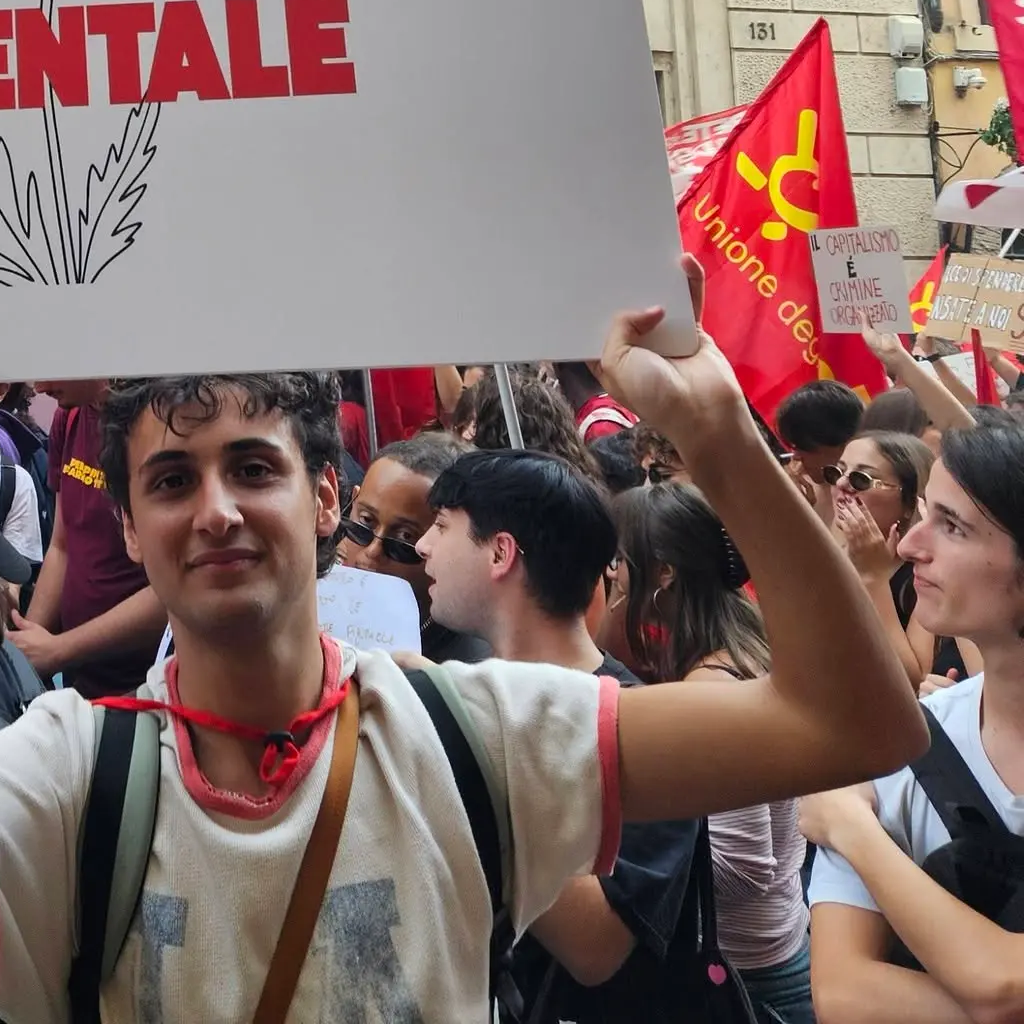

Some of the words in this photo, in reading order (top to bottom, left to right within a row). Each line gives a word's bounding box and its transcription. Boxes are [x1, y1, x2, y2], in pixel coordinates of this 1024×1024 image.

[748, 22, 776, 41] 131
[694, 192, 778, 298] Unione
[810, 234, 821, 252] IL
[826, 228, 901, 256] CAPITALISMO
[829, 277, 883, 305] CRIMINE
